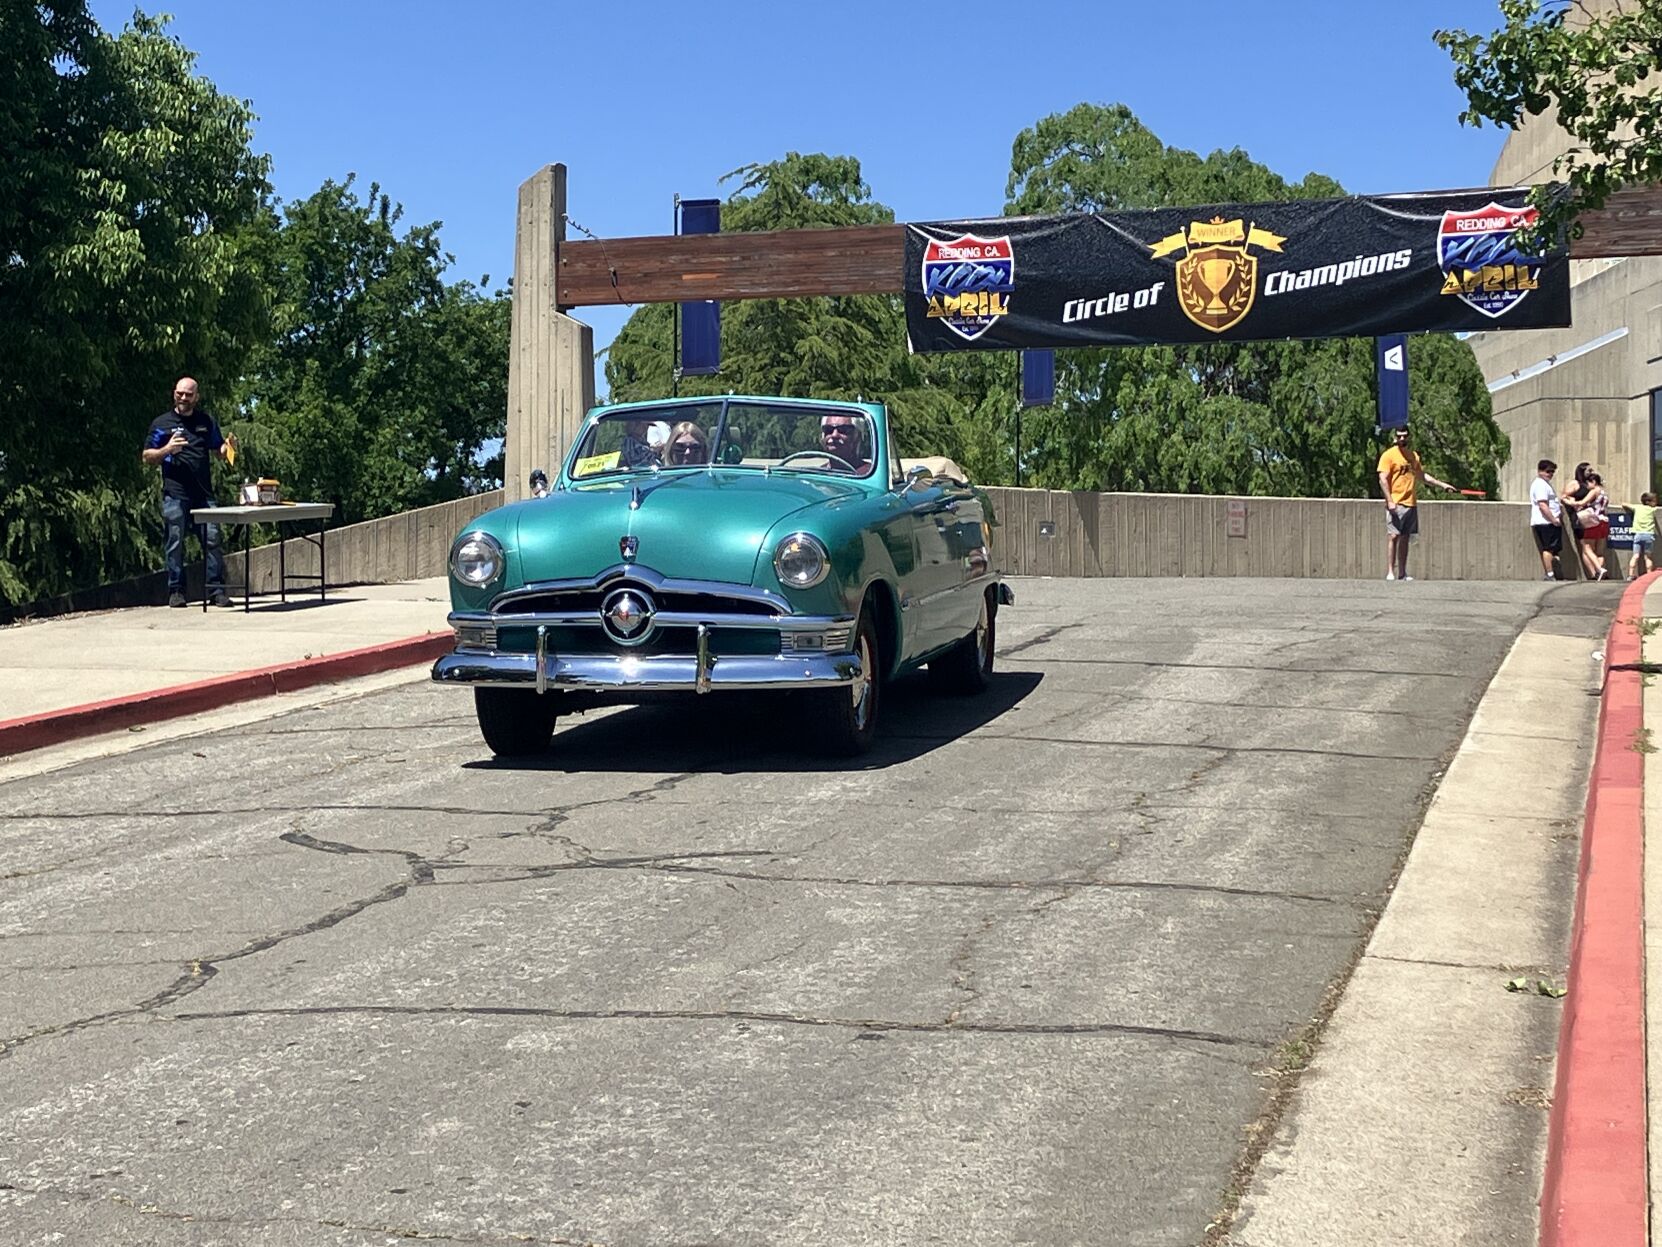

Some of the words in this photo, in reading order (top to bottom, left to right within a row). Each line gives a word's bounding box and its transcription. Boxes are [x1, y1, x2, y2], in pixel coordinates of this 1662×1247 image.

[1456, 218, 1507, 231] REDDING
[1196, 226, 1236, 238] WINNER
[938, 247, 981, 259] REDDING
[1263, 248, 1413, 296] Champions
[1062, 290, 1129, 323] Circle
[1132, 281, 1166, 310] of
